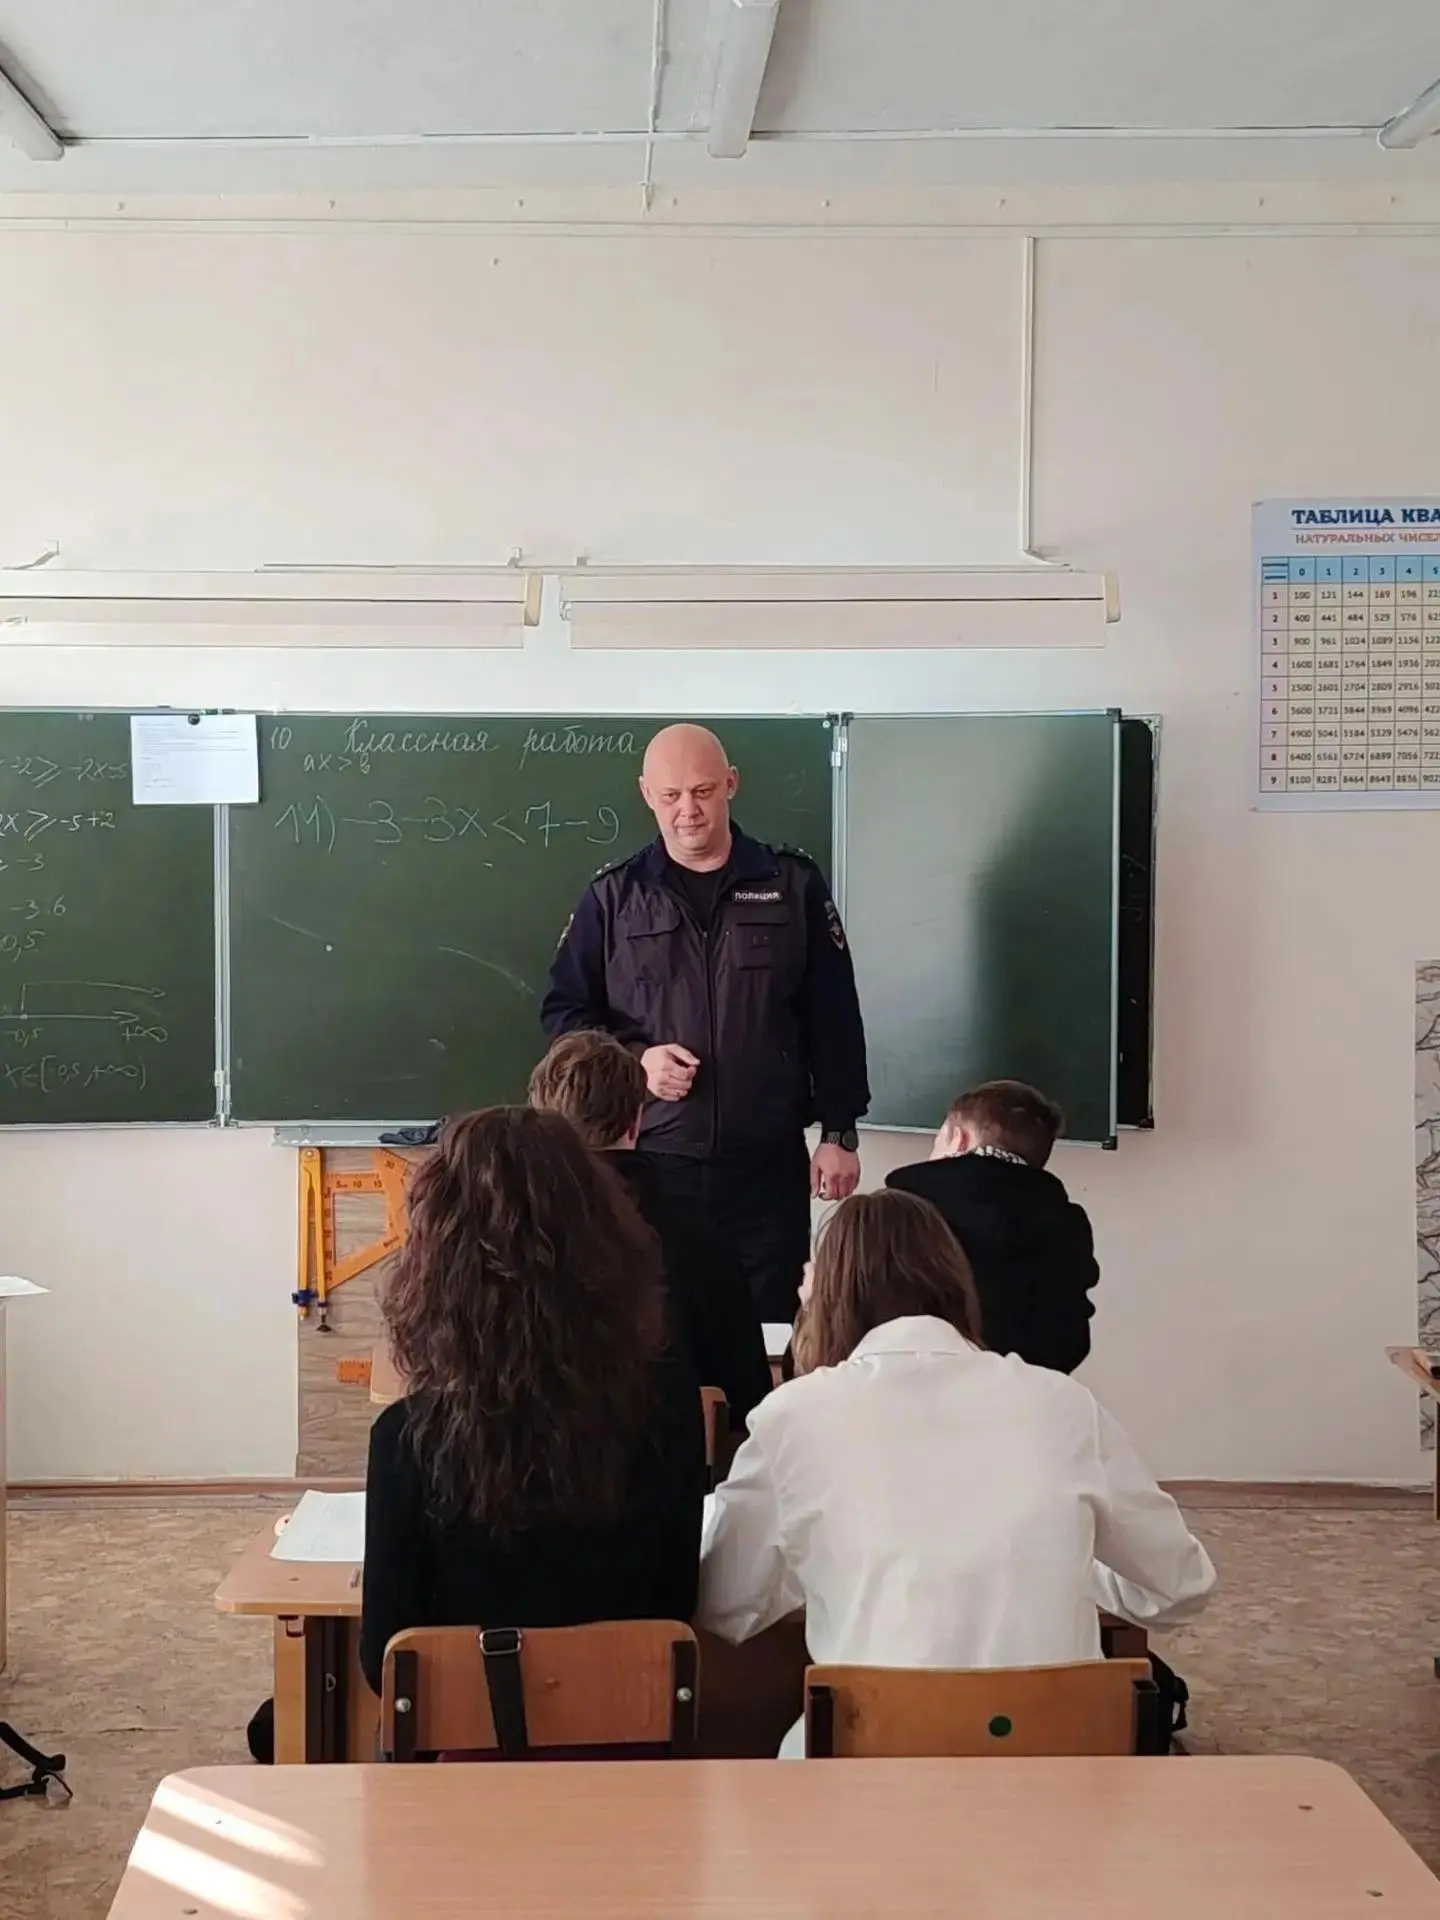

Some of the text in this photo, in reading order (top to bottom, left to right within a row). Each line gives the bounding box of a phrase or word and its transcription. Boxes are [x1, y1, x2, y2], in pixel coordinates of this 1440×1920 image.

[1291, 508, 1395, 525] ТАБЛИЦА
[1295, 532, 1395, 545] НАТУРАЛЬНЫХ
[270, 726, 293, 750] 10
[342, 717, 637, 771] Классная работа
